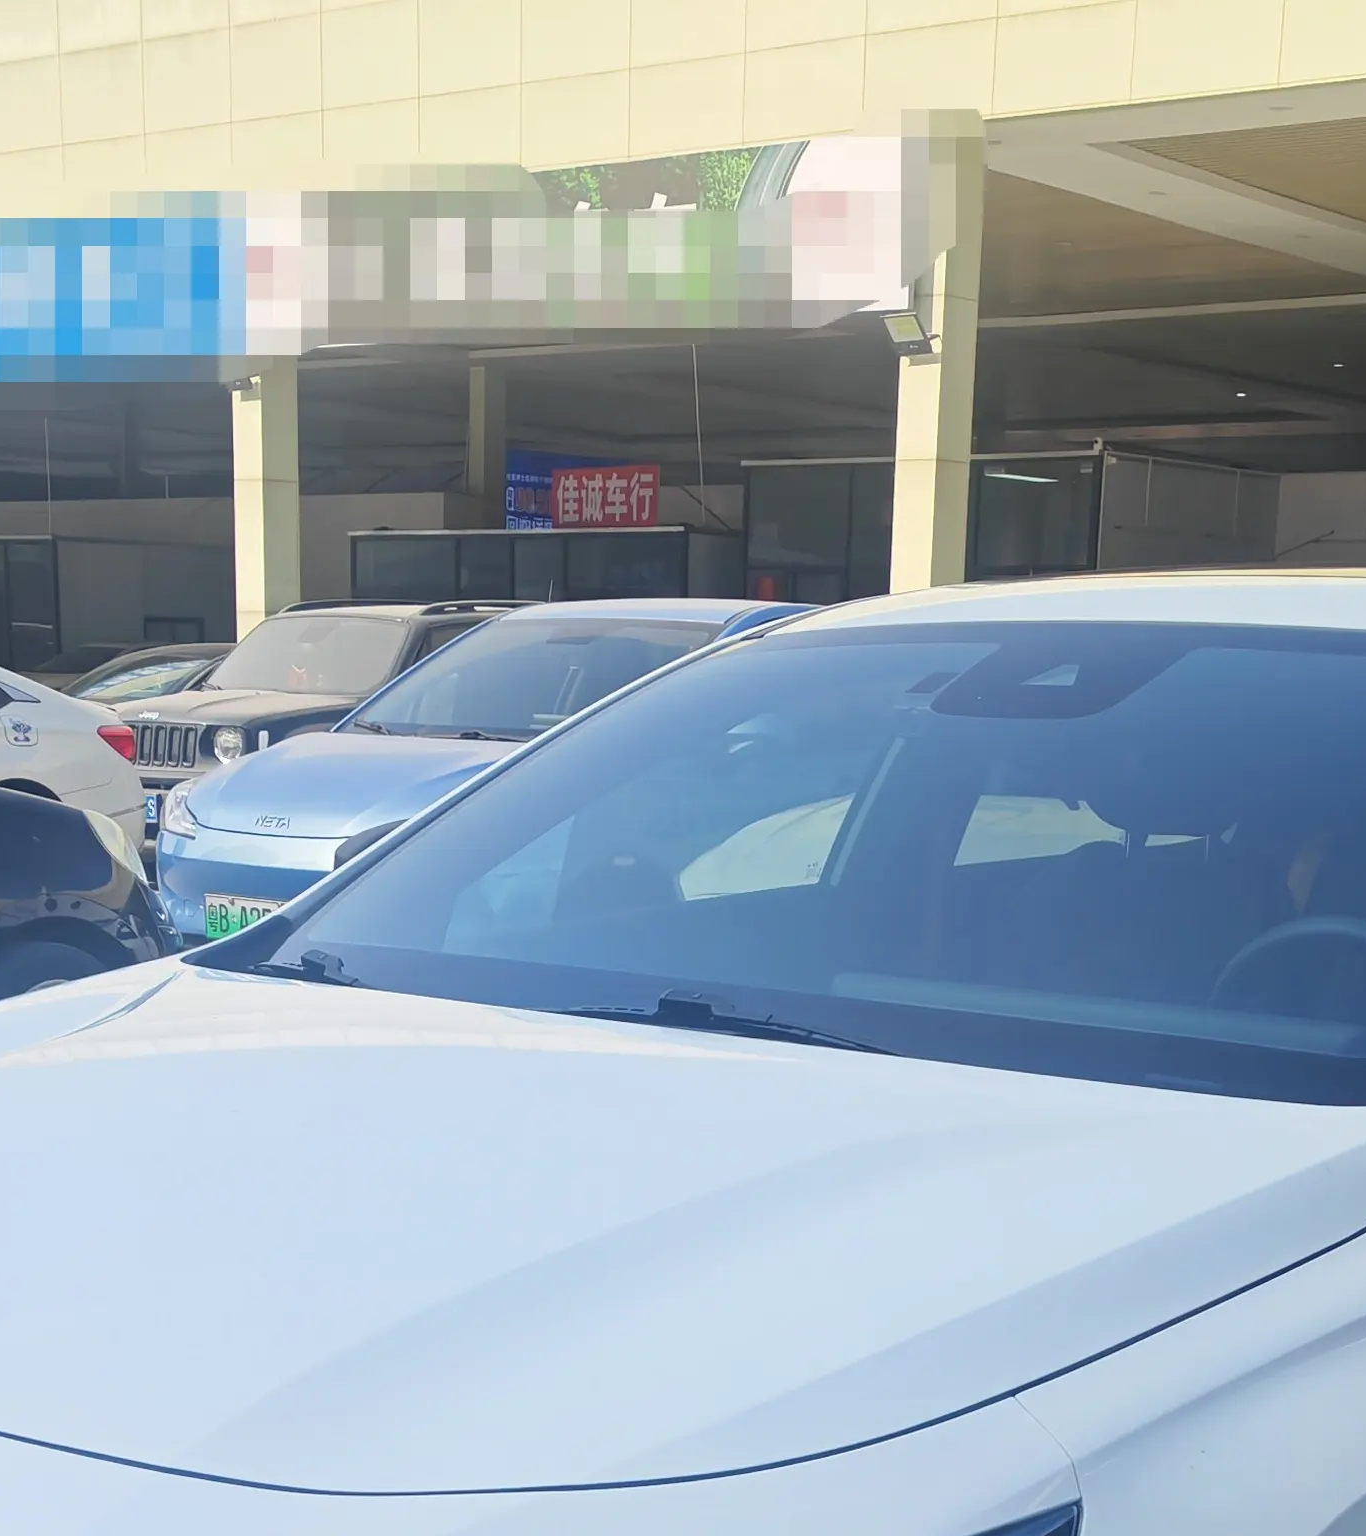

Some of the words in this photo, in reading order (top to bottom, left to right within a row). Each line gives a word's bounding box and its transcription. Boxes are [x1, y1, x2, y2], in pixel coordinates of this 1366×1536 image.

[557, 472, 653, 524] 佳诚车行
[255, 815, 291, 829] NETA
